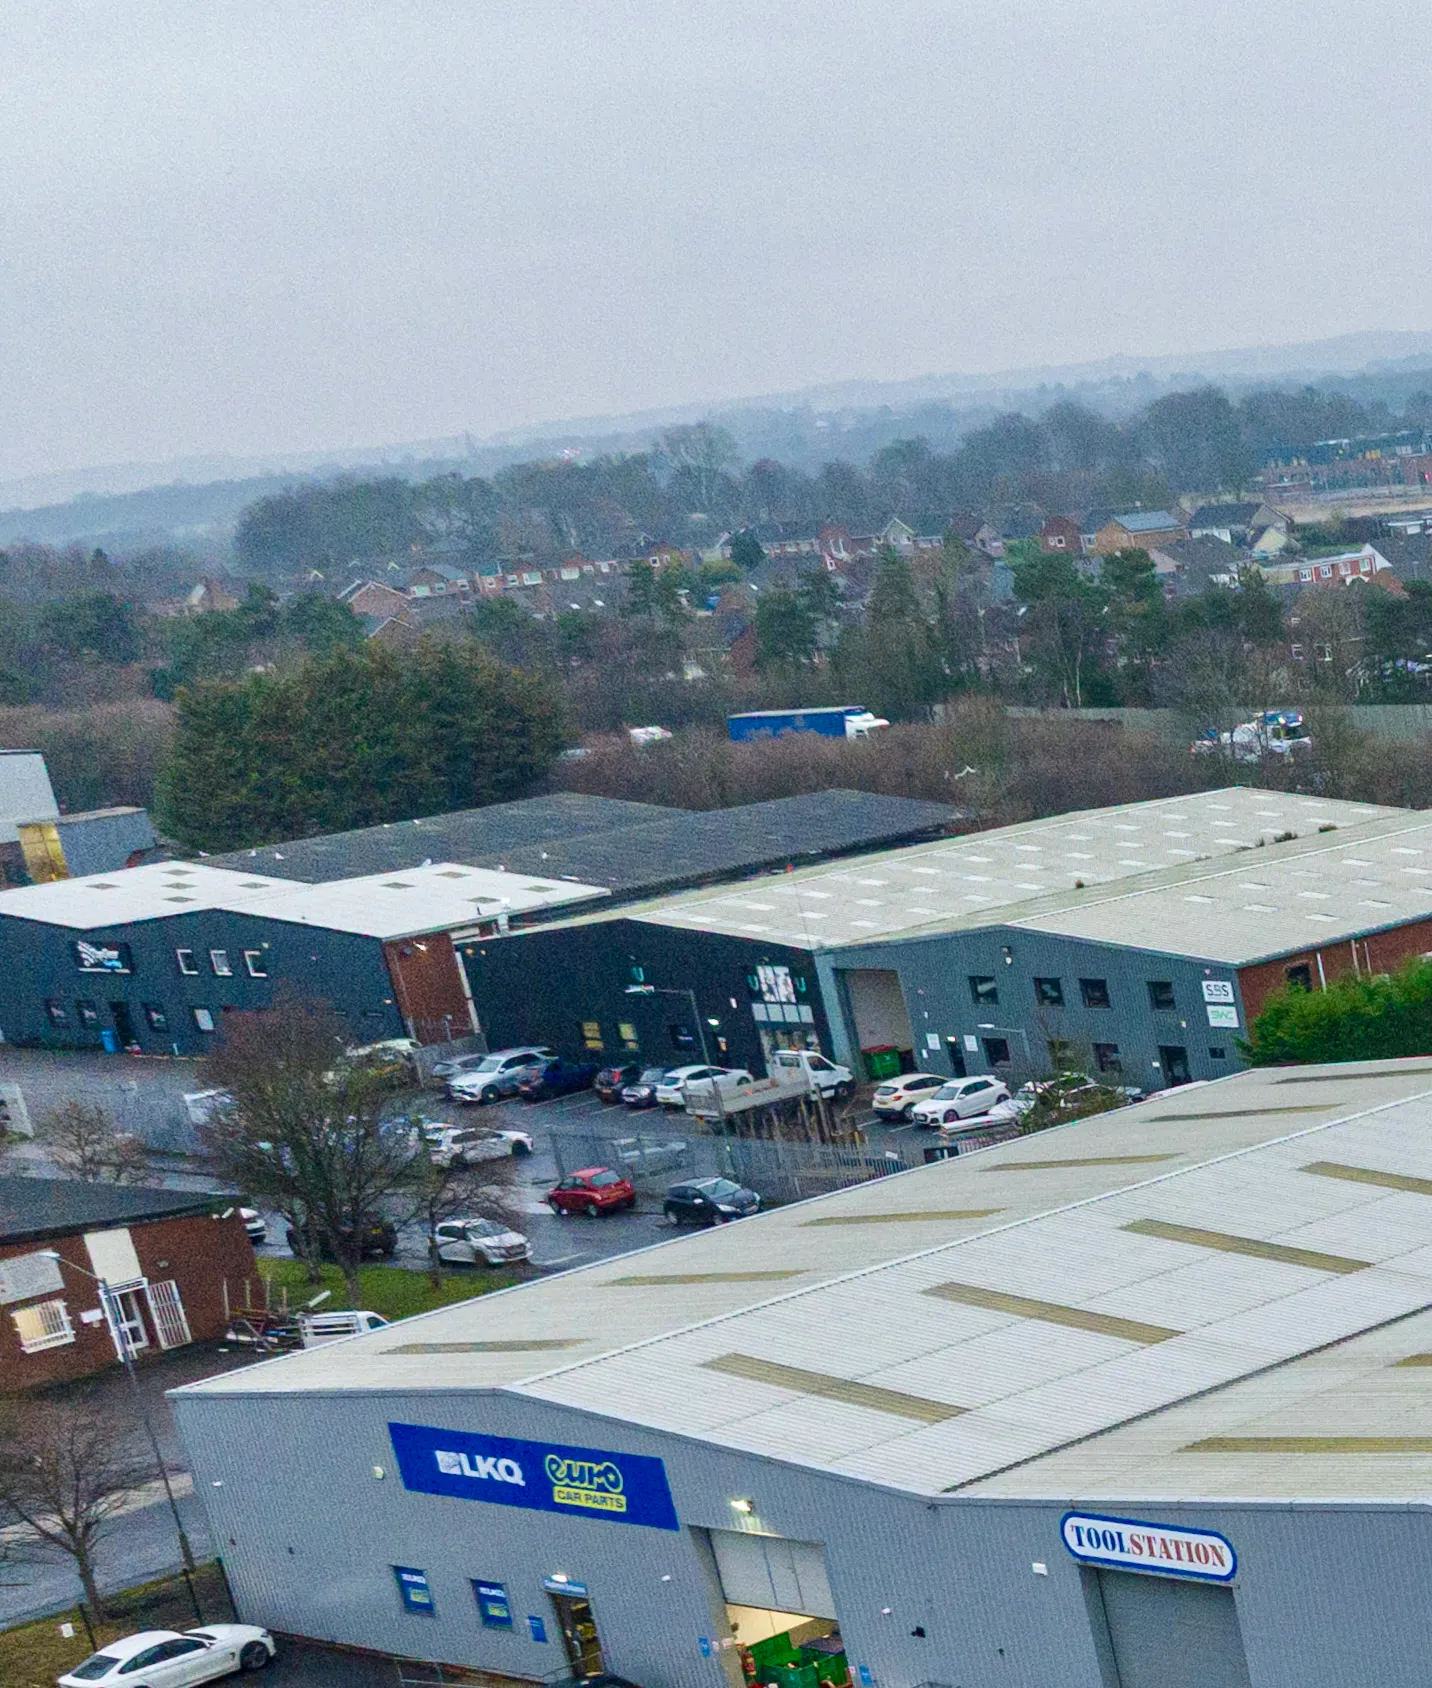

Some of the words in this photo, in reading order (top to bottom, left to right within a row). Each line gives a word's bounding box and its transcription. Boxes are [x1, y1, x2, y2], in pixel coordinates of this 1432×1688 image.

[459, 1453, 525, 1486] LKQ
[545, 1454, 623, 1493] euro
[557, 1490, 582, 1502] CAR
[584, 1493, 624, 1509] PARTS
[1071, 1523, 1226, 1567] TOOLSTATION
